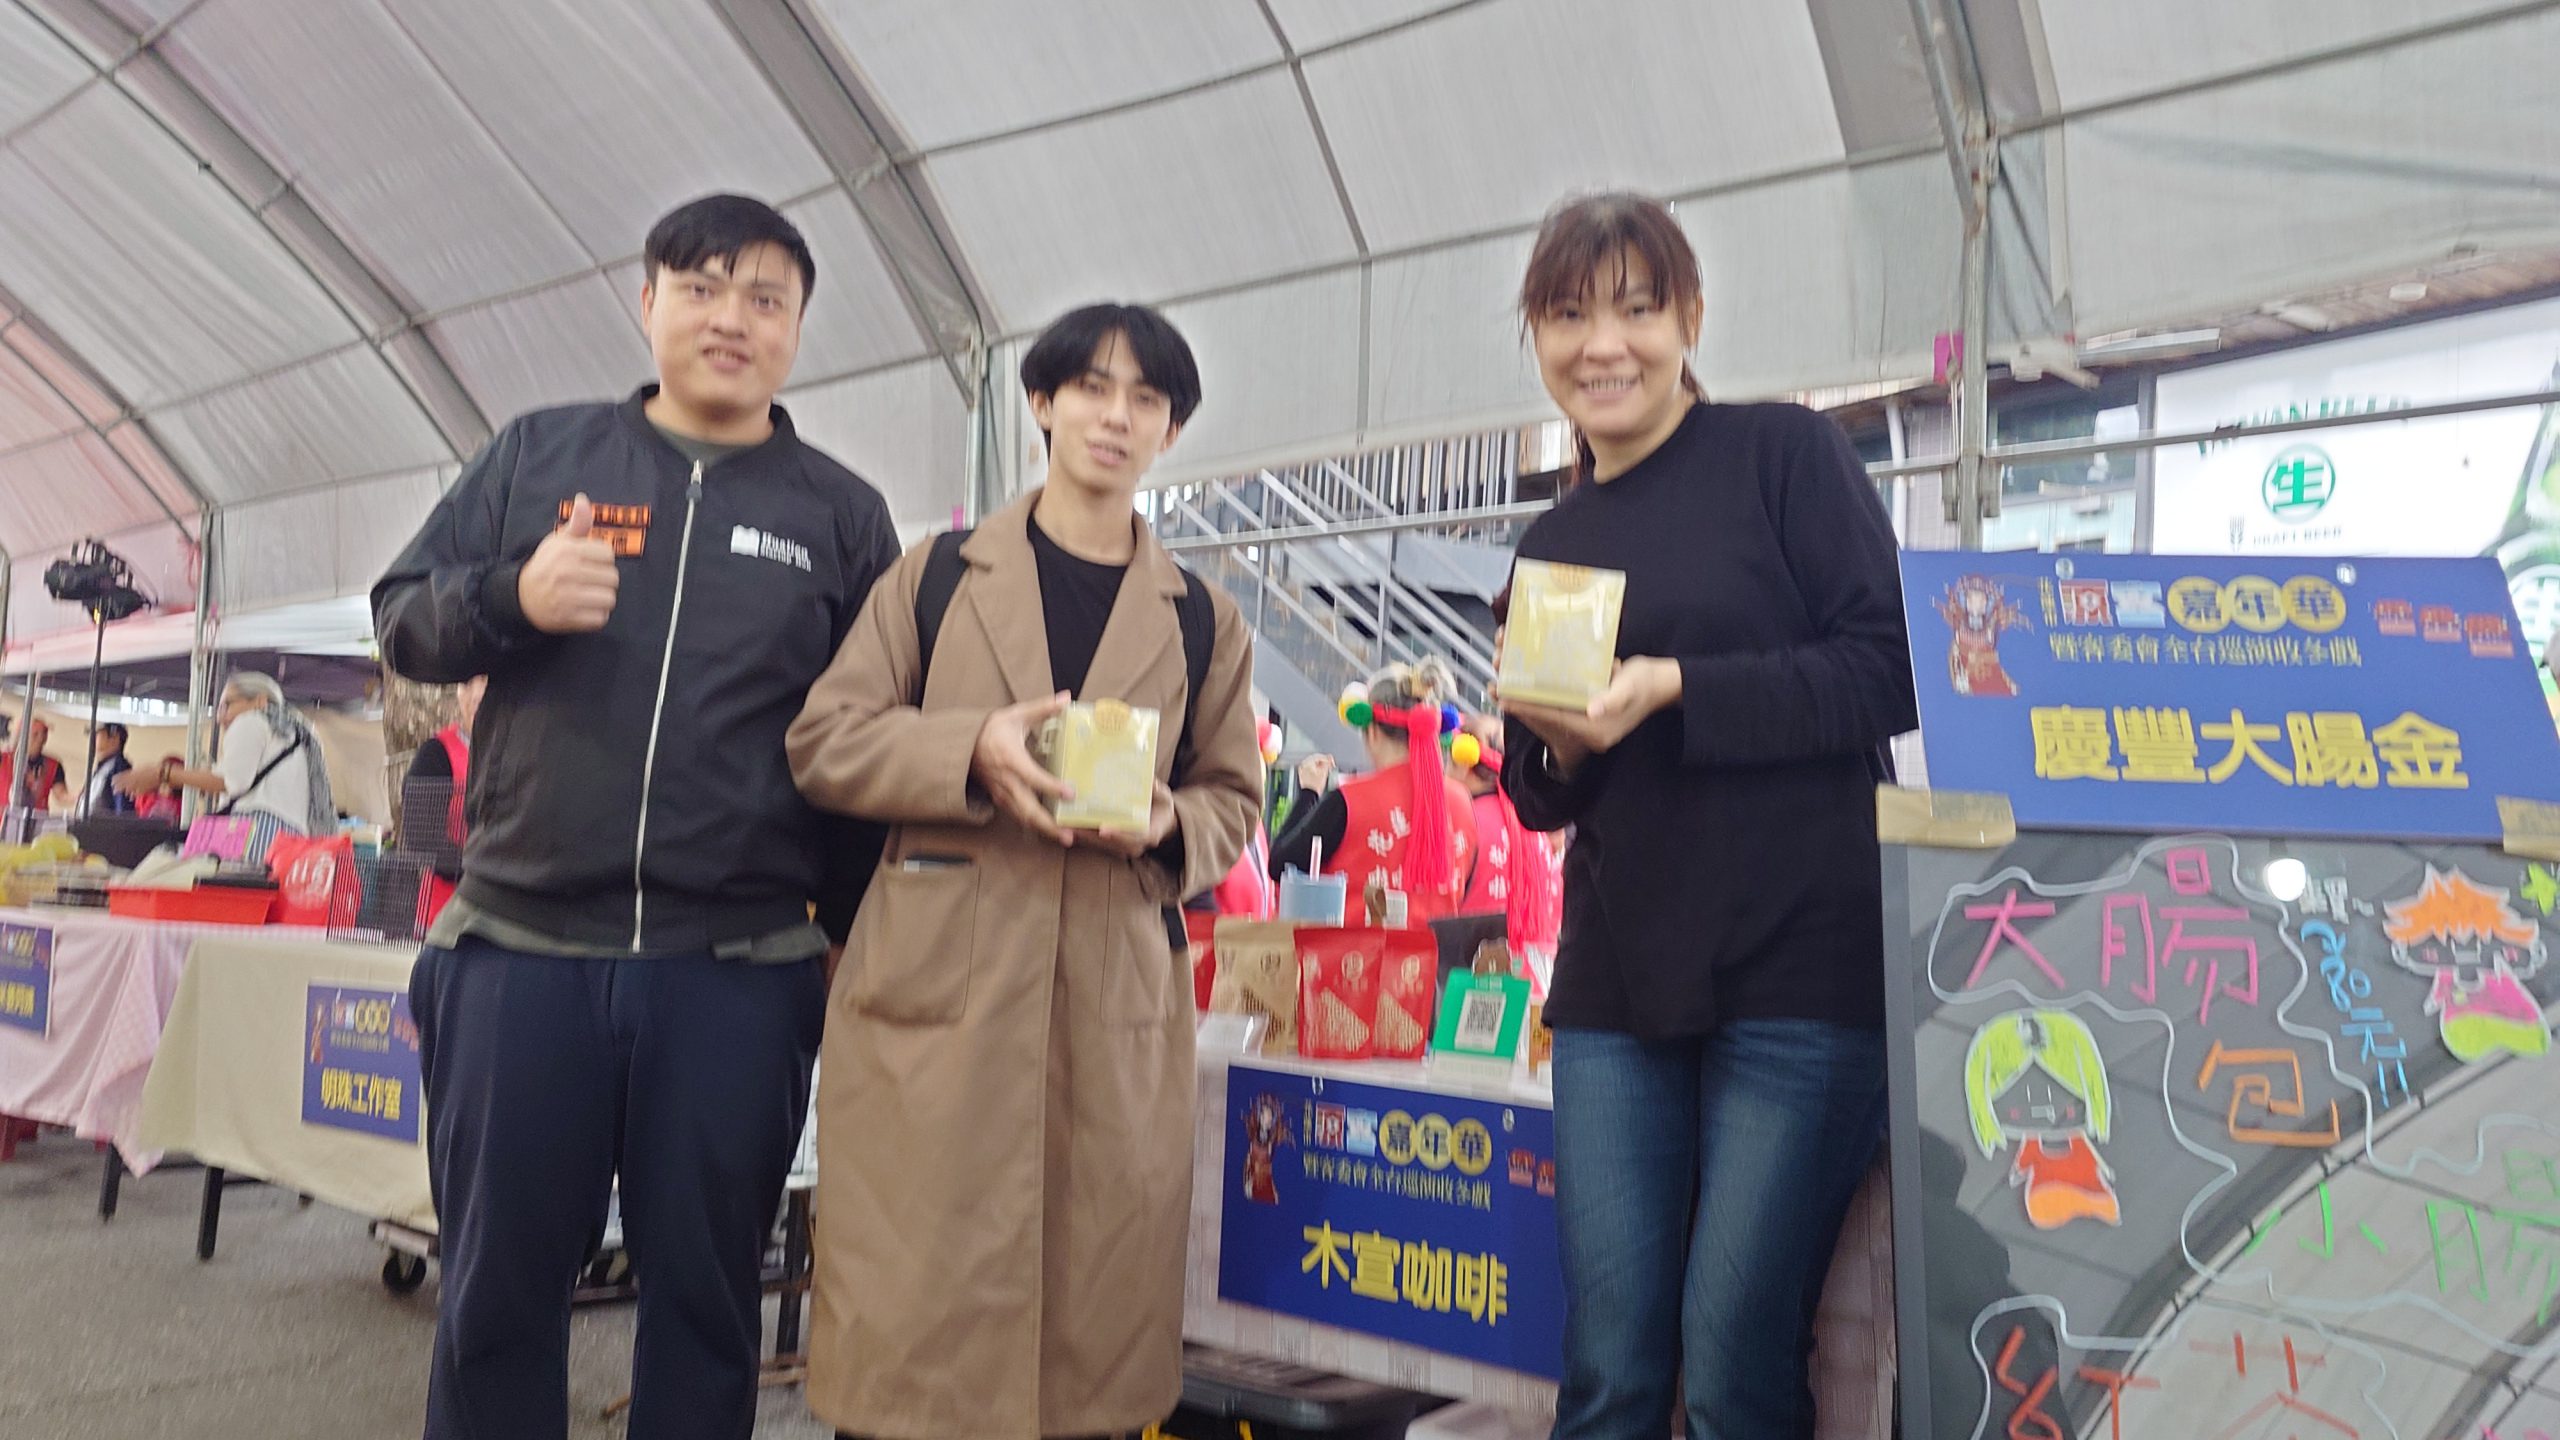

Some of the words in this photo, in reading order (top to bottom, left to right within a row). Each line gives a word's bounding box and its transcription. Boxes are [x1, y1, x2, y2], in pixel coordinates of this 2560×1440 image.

[2271, 456, 2325, 514] 生
[2199, 1040, 2341, 1147] 包
[1302, 1219, 1508, 1327] 木宣咖啡
